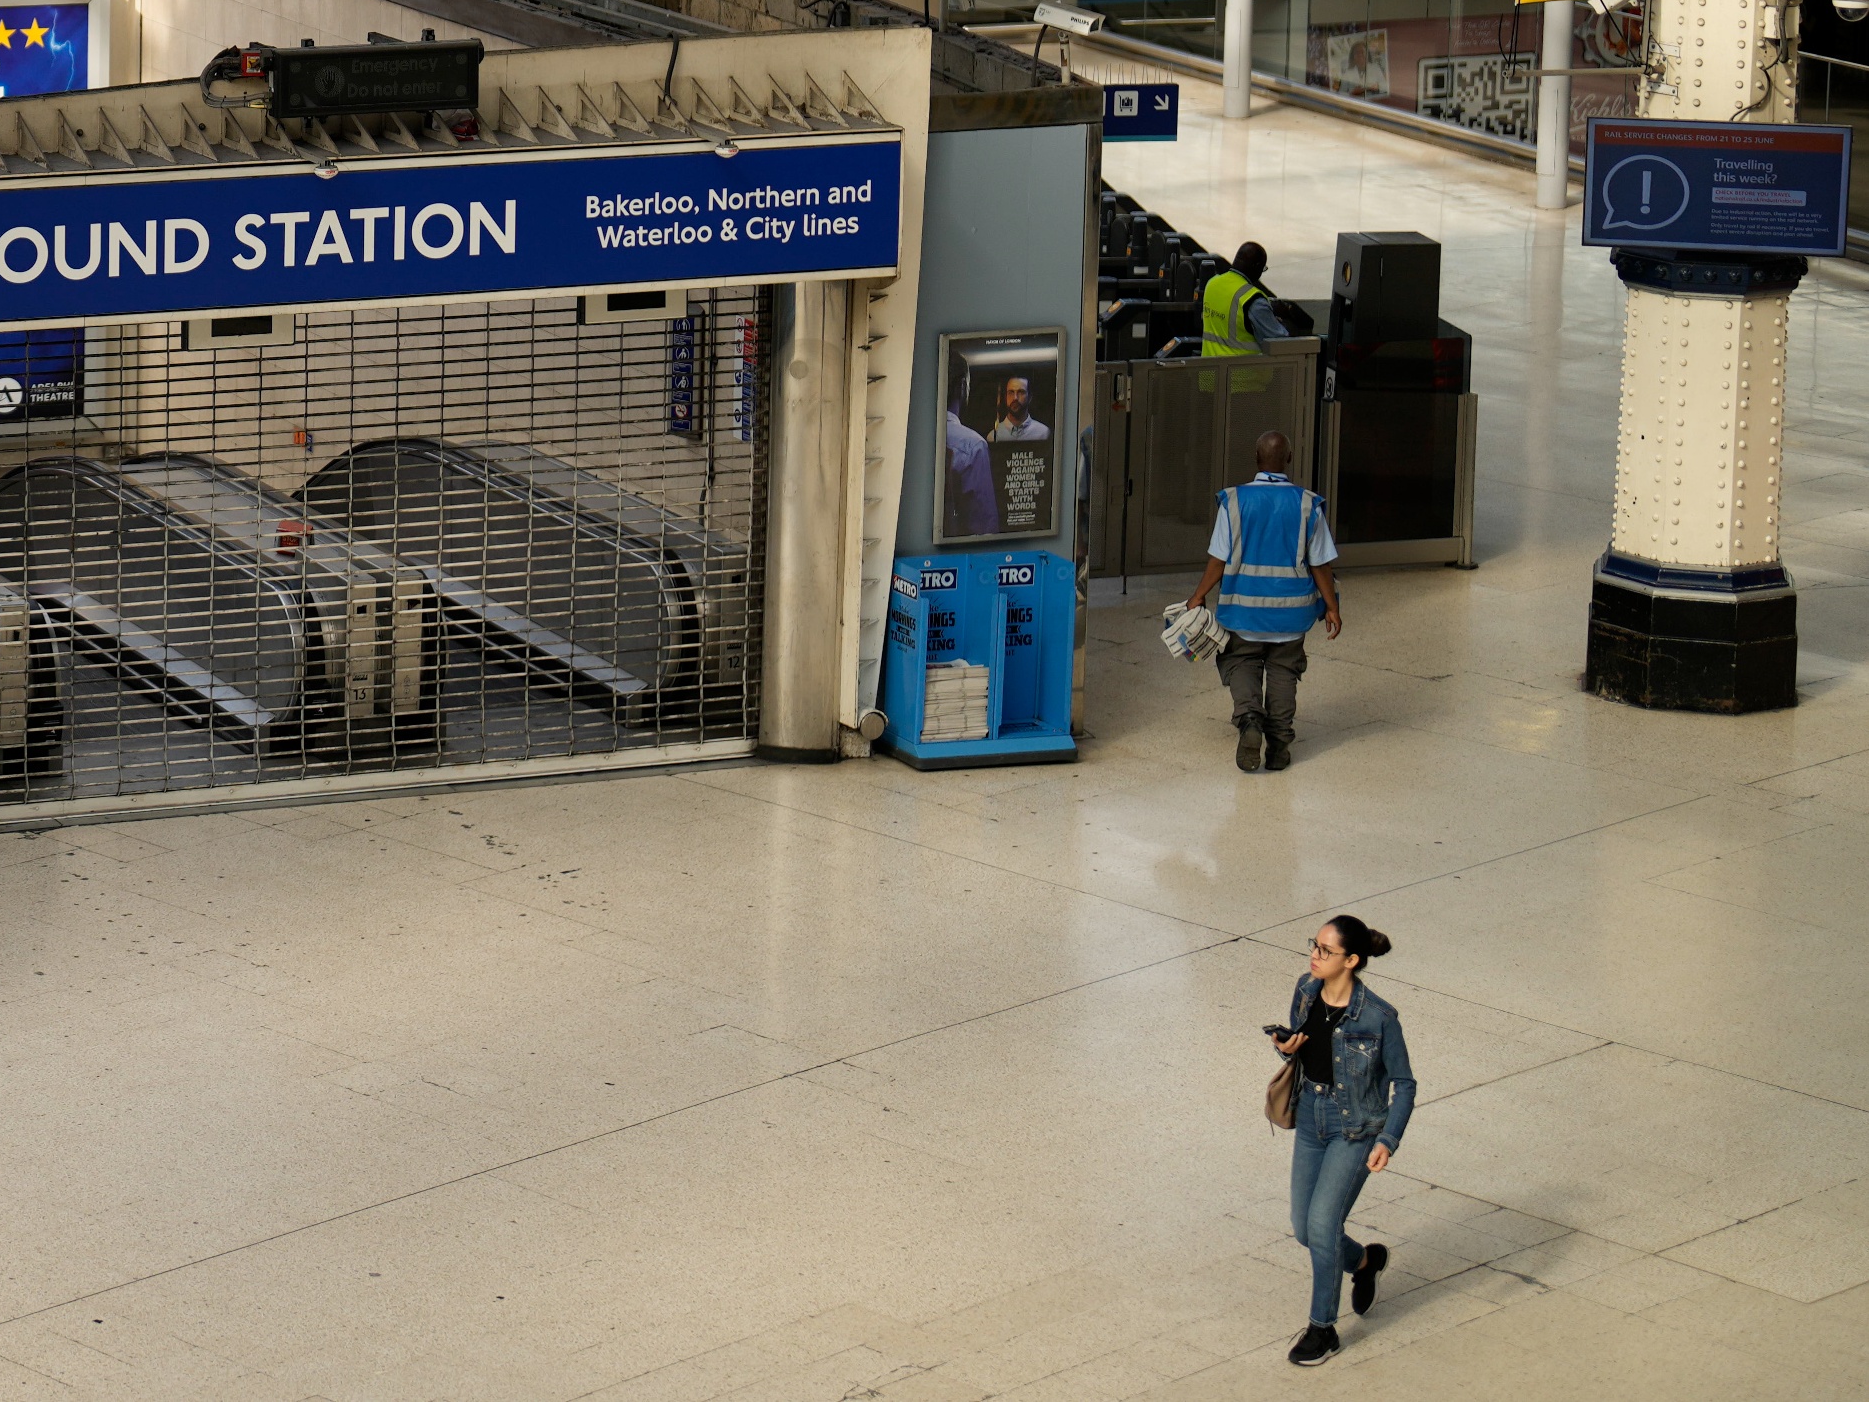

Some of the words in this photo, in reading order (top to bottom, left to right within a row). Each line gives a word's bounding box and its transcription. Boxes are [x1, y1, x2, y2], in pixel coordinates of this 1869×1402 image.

[1070, 16, 1090, 26] PHILIPS
[351, 57, 439, 76] Emergency
[347, 84, 369, 98] Do
[373, 82, 399, 96] not
[402, 80, 442, 94] enter
[1604, 130, 1622, 139] RAIL
[1623, 131, 1655, 140] SERVICE
[1656, 132, 1694, 141] CHANGES:
[1695, 134, 1718, 142] FROM
[1719, 135, 1729, 143] 21
[1731, 135, 1742, 143] TO
[1743, 136, 1753, 144] 25
[1754, 136, 1775, 144] JUNE
[1714, 158, 1774, 173] Travelling
[1713, 172, 1736, 183] this
[1739, 173, 1778, 185] week?
[585, 191, 700, 218] Bakerloo,
[708, 186, 820, 212] Northern
[827, 179, 872, 204] and
[231, 199, 517, 271] STATION
[596, 222, 713, 249] Waterloo
[720, 218, 739, 241] &
[745, 214, 796, 243] City
[803, 213, 860, 237] lines
[1011, 451, 1034, 460] MALE
[1006, 458, 1044, 468] VIOLENCE
[1011, 465, 1046, 474] AGAINST
[1004, 481, 1021, 489] AND
[1022, 479, 1045, 488] GIRLS
[1006, 473, 1036, 482] WOMEN
[1008, 487, 1040, 496] STARTS
[1012, 495, 1033, 503] WITH
[894, 576, 917, 598] METRO
